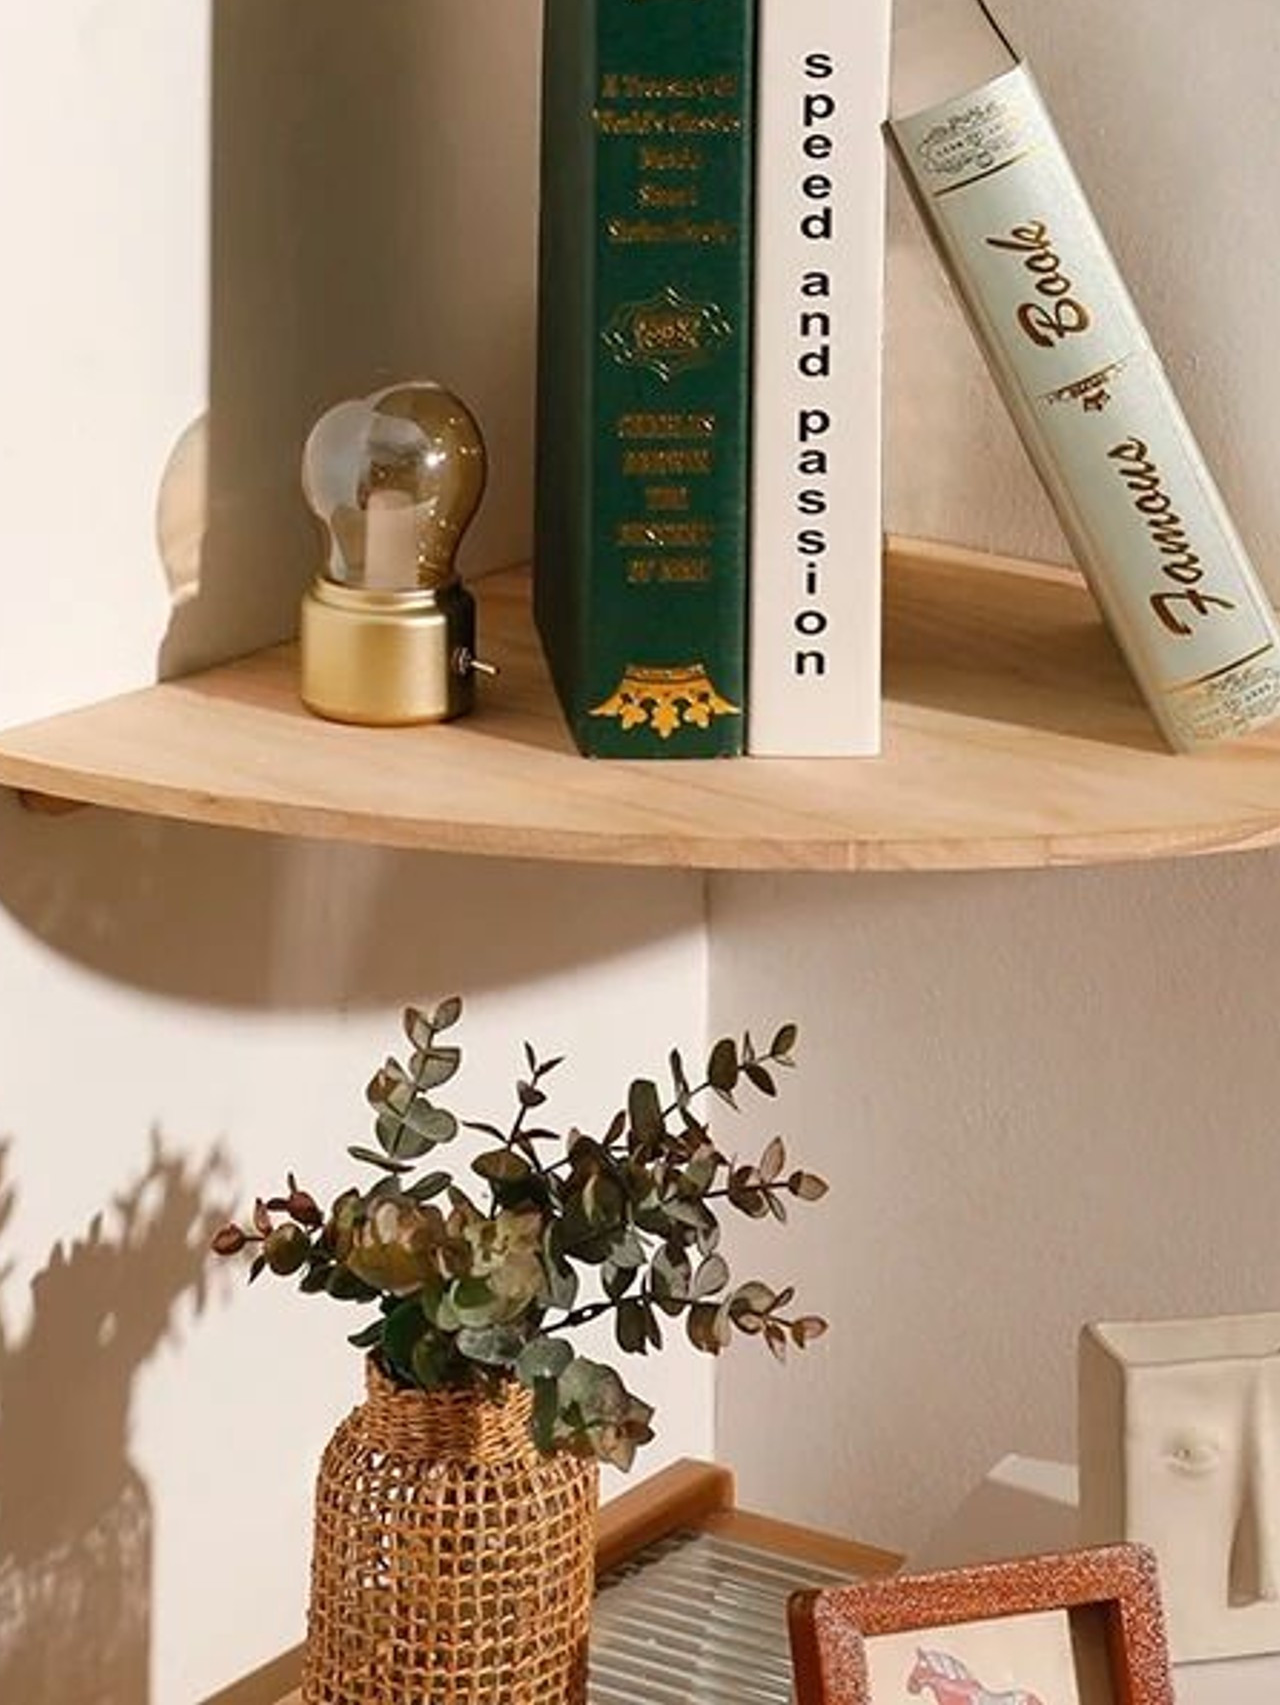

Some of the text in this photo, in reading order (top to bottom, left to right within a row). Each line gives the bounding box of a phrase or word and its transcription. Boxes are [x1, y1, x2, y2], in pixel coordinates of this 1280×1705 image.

[794, 52, 835, 676] speed and passion
[985, 221, 1236, 637] Famous Book
